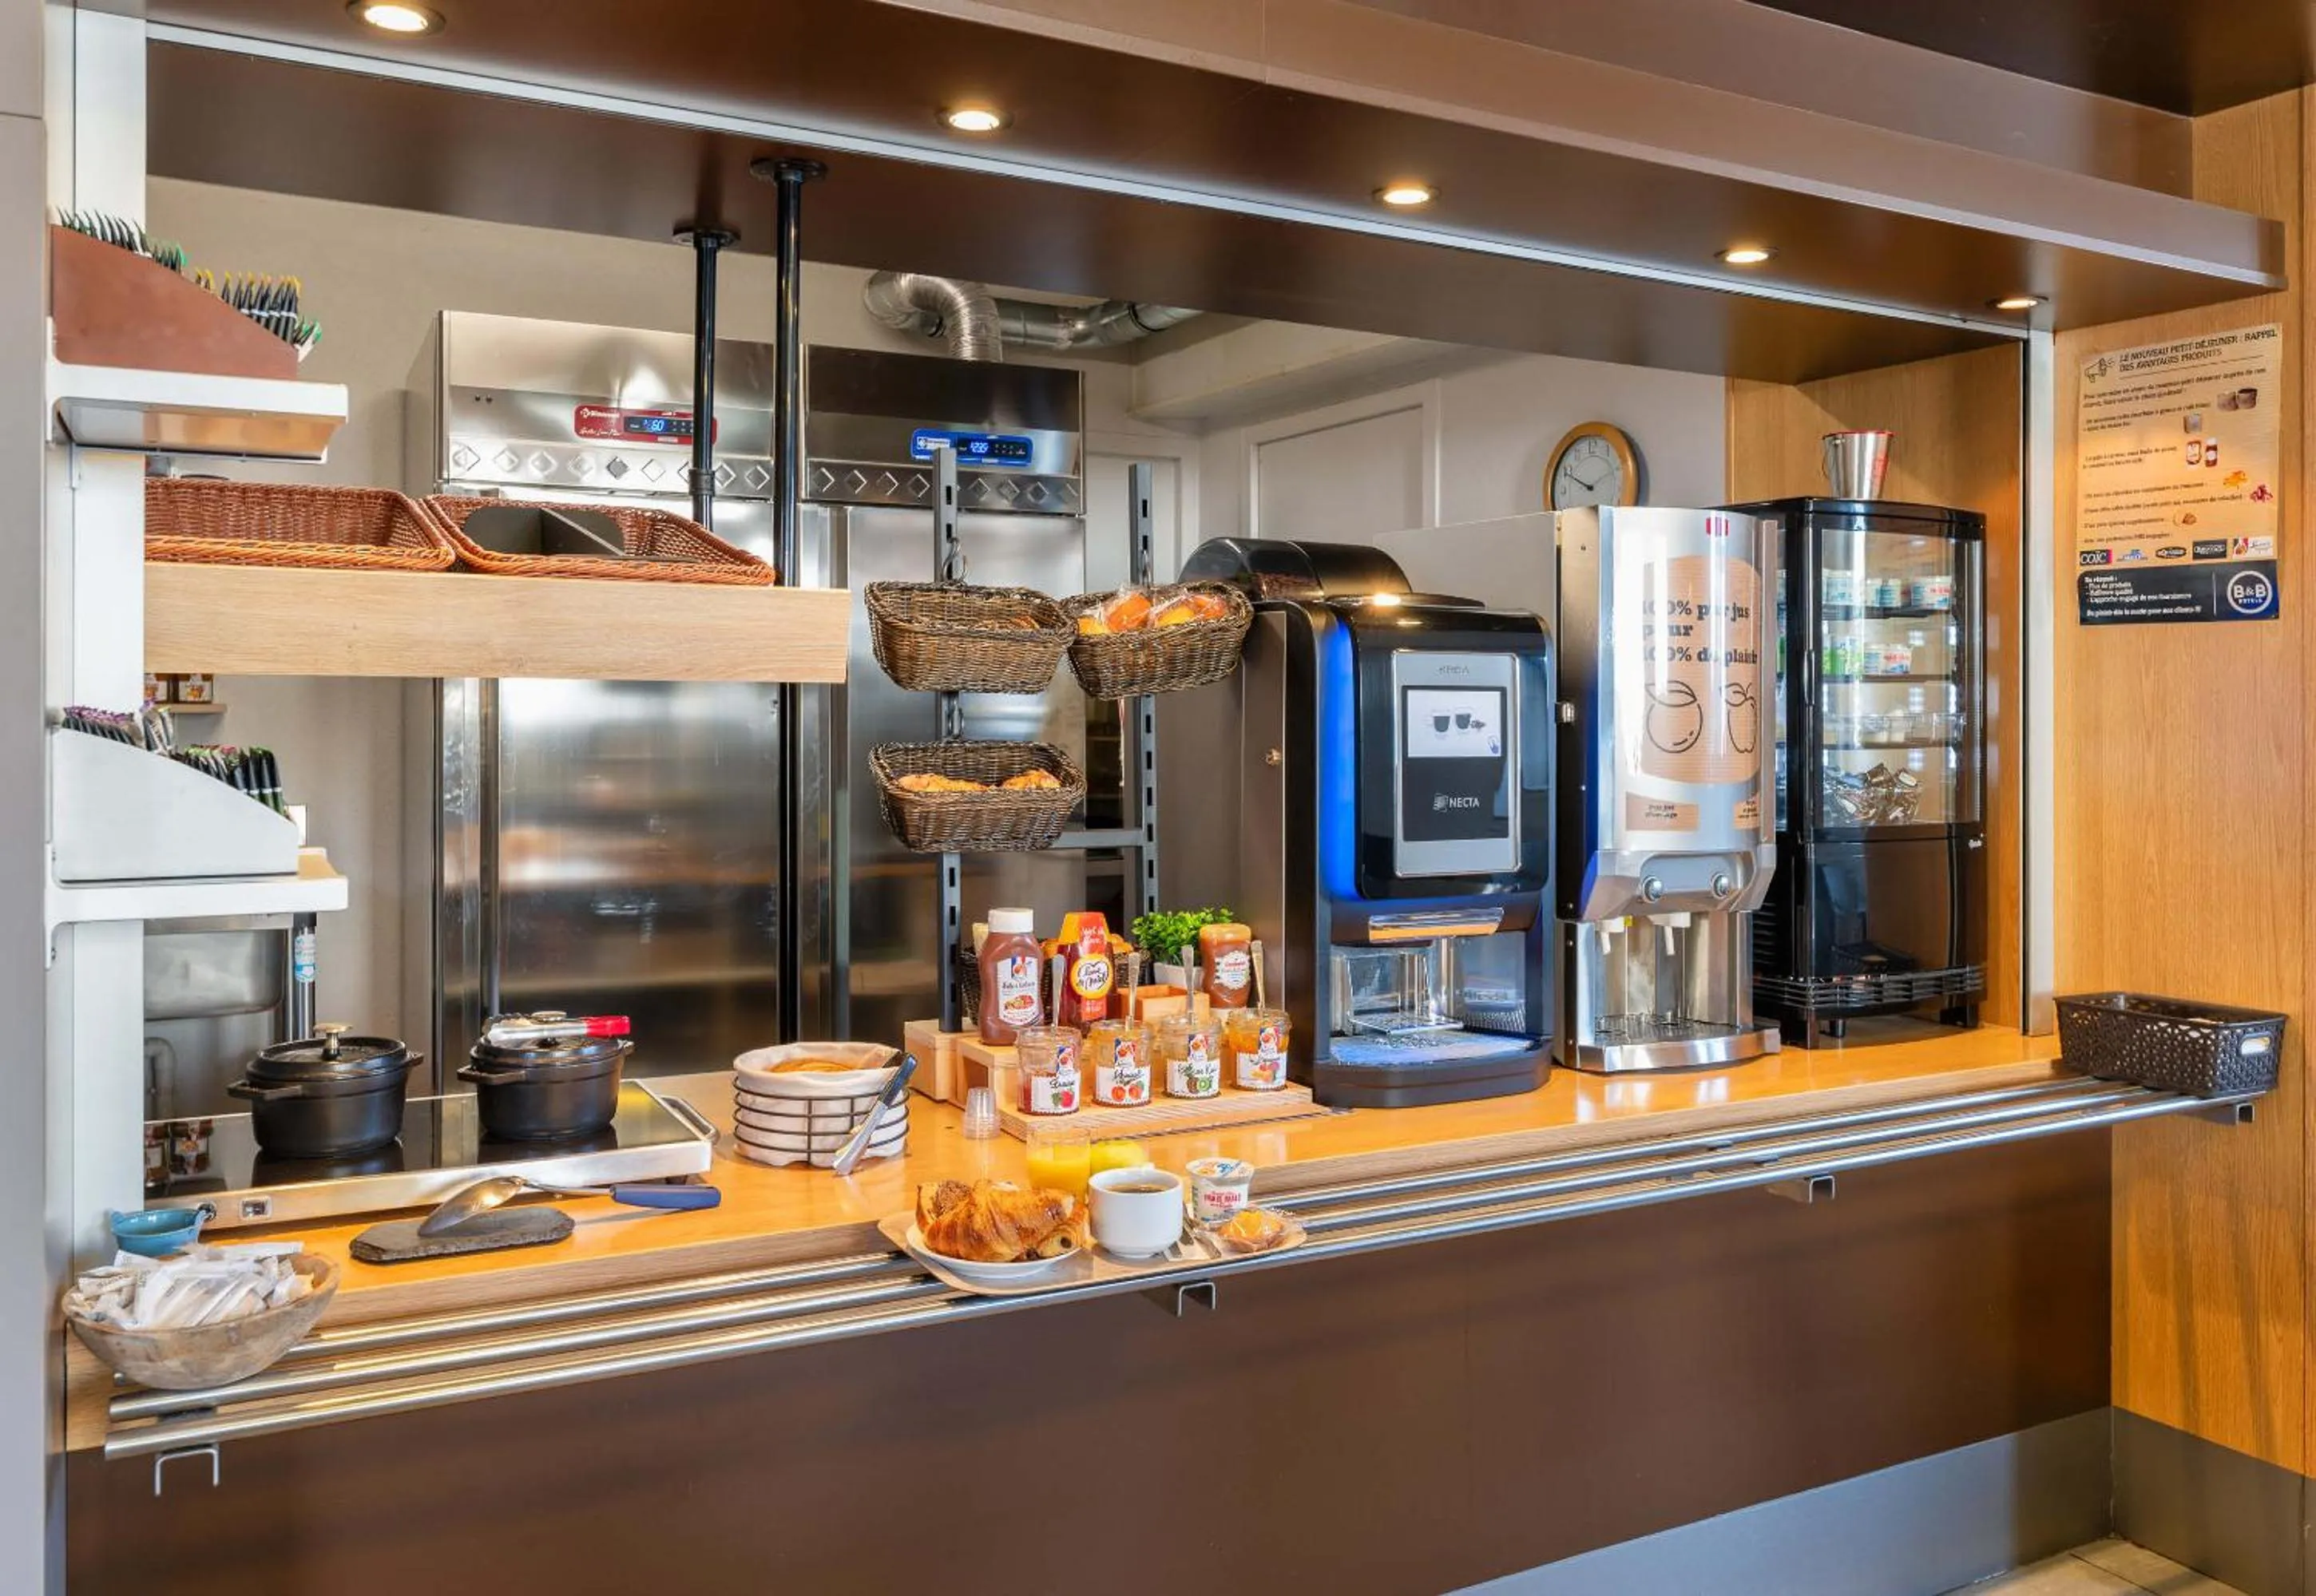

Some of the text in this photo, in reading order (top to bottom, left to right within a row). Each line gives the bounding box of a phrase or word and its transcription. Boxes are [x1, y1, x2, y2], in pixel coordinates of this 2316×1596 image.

[2131, 347, 2169, 361] NOUVEAU
[2244, 328, 2278, 343] RAPPEL
[2181, 348, 2223, 363] PRODUITS
[2234, 584, 2267, 598] B&B
[1449, 798, 1480, 809] NECTA
